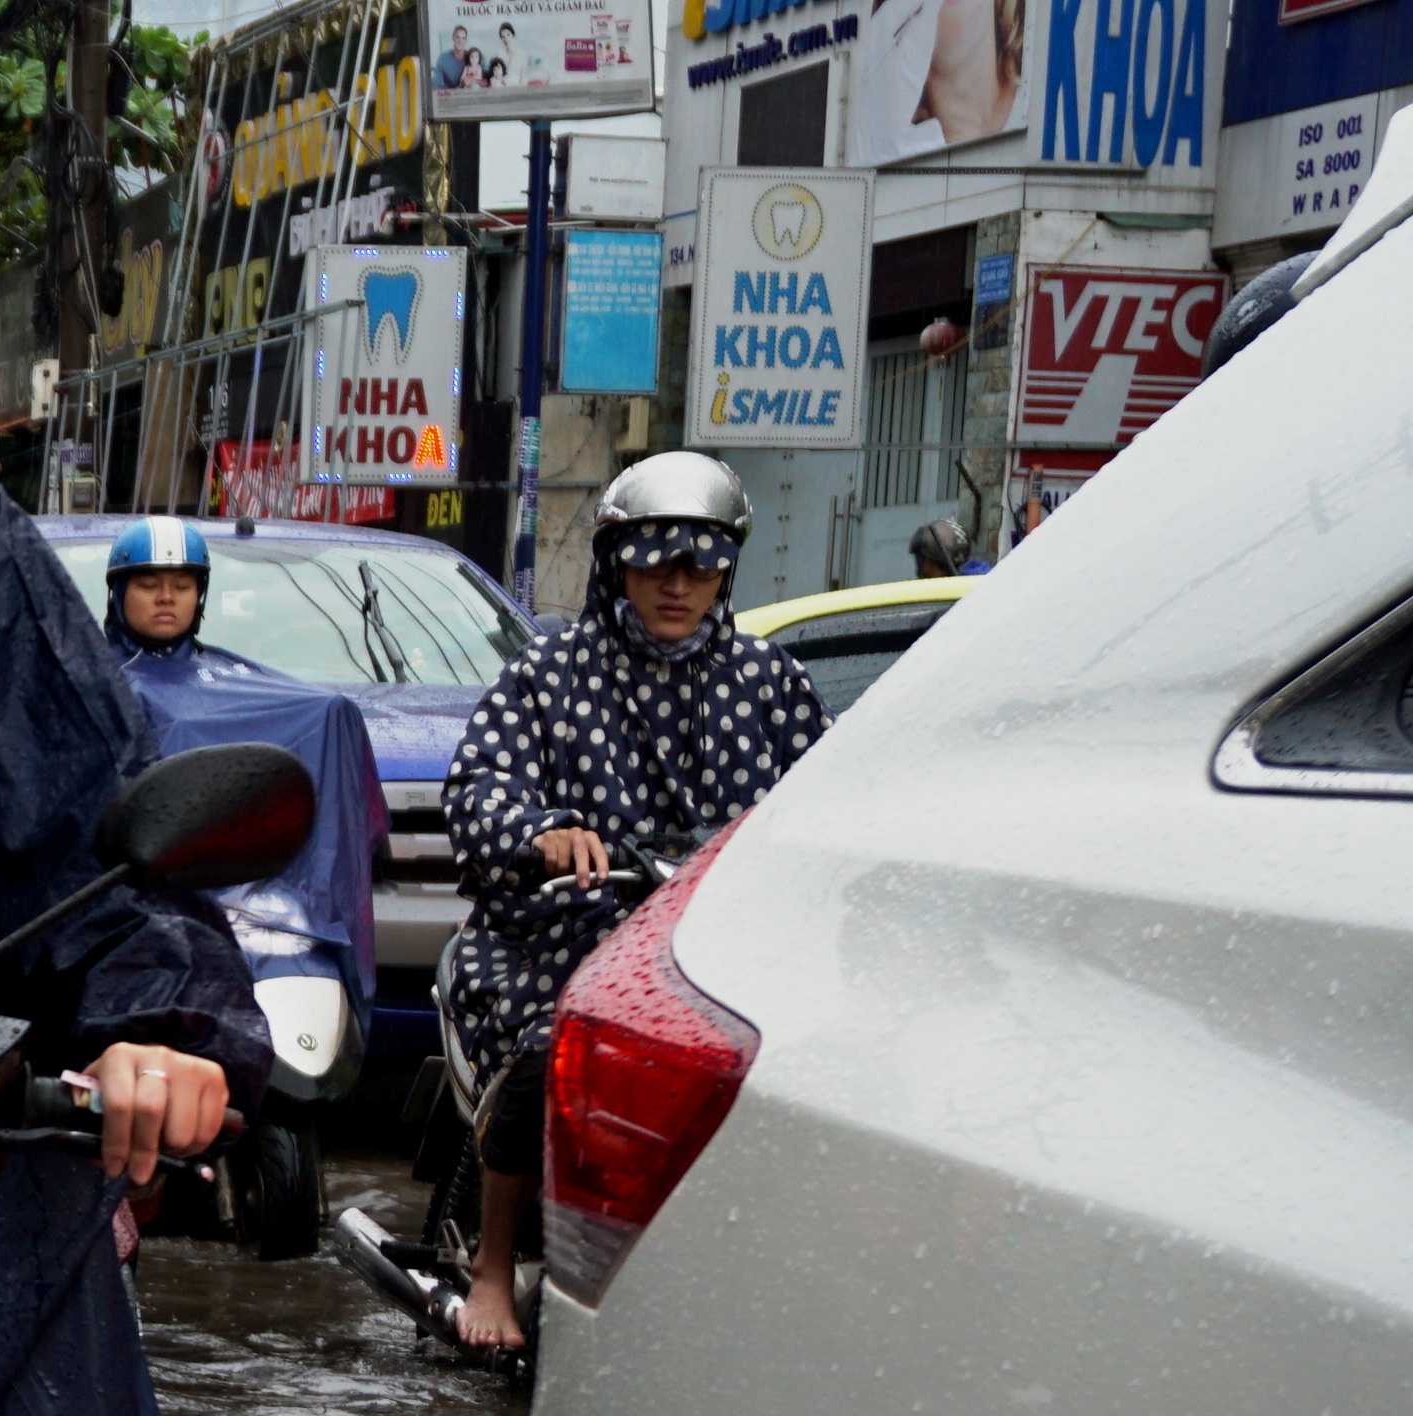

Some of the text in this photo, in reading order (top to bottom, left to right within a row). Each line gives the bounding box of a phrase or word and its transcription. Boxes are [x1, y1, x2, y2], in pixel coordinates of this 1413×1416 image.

[1042, 0, 1204, 168] KHOA
[1299, 124, 1323, 148] ISO
[1295, 150, 1361, 181] SA 8000
[733, 271, 832, 315] NHA
[1039, 278, 1215, 363] VTEC
[714, 325, 845, 370] KHOA
[339, 377, 429, 415] NHA
[709, 372, 842, 426] iSMILE
[324, 424, 447, 466] KHOA
